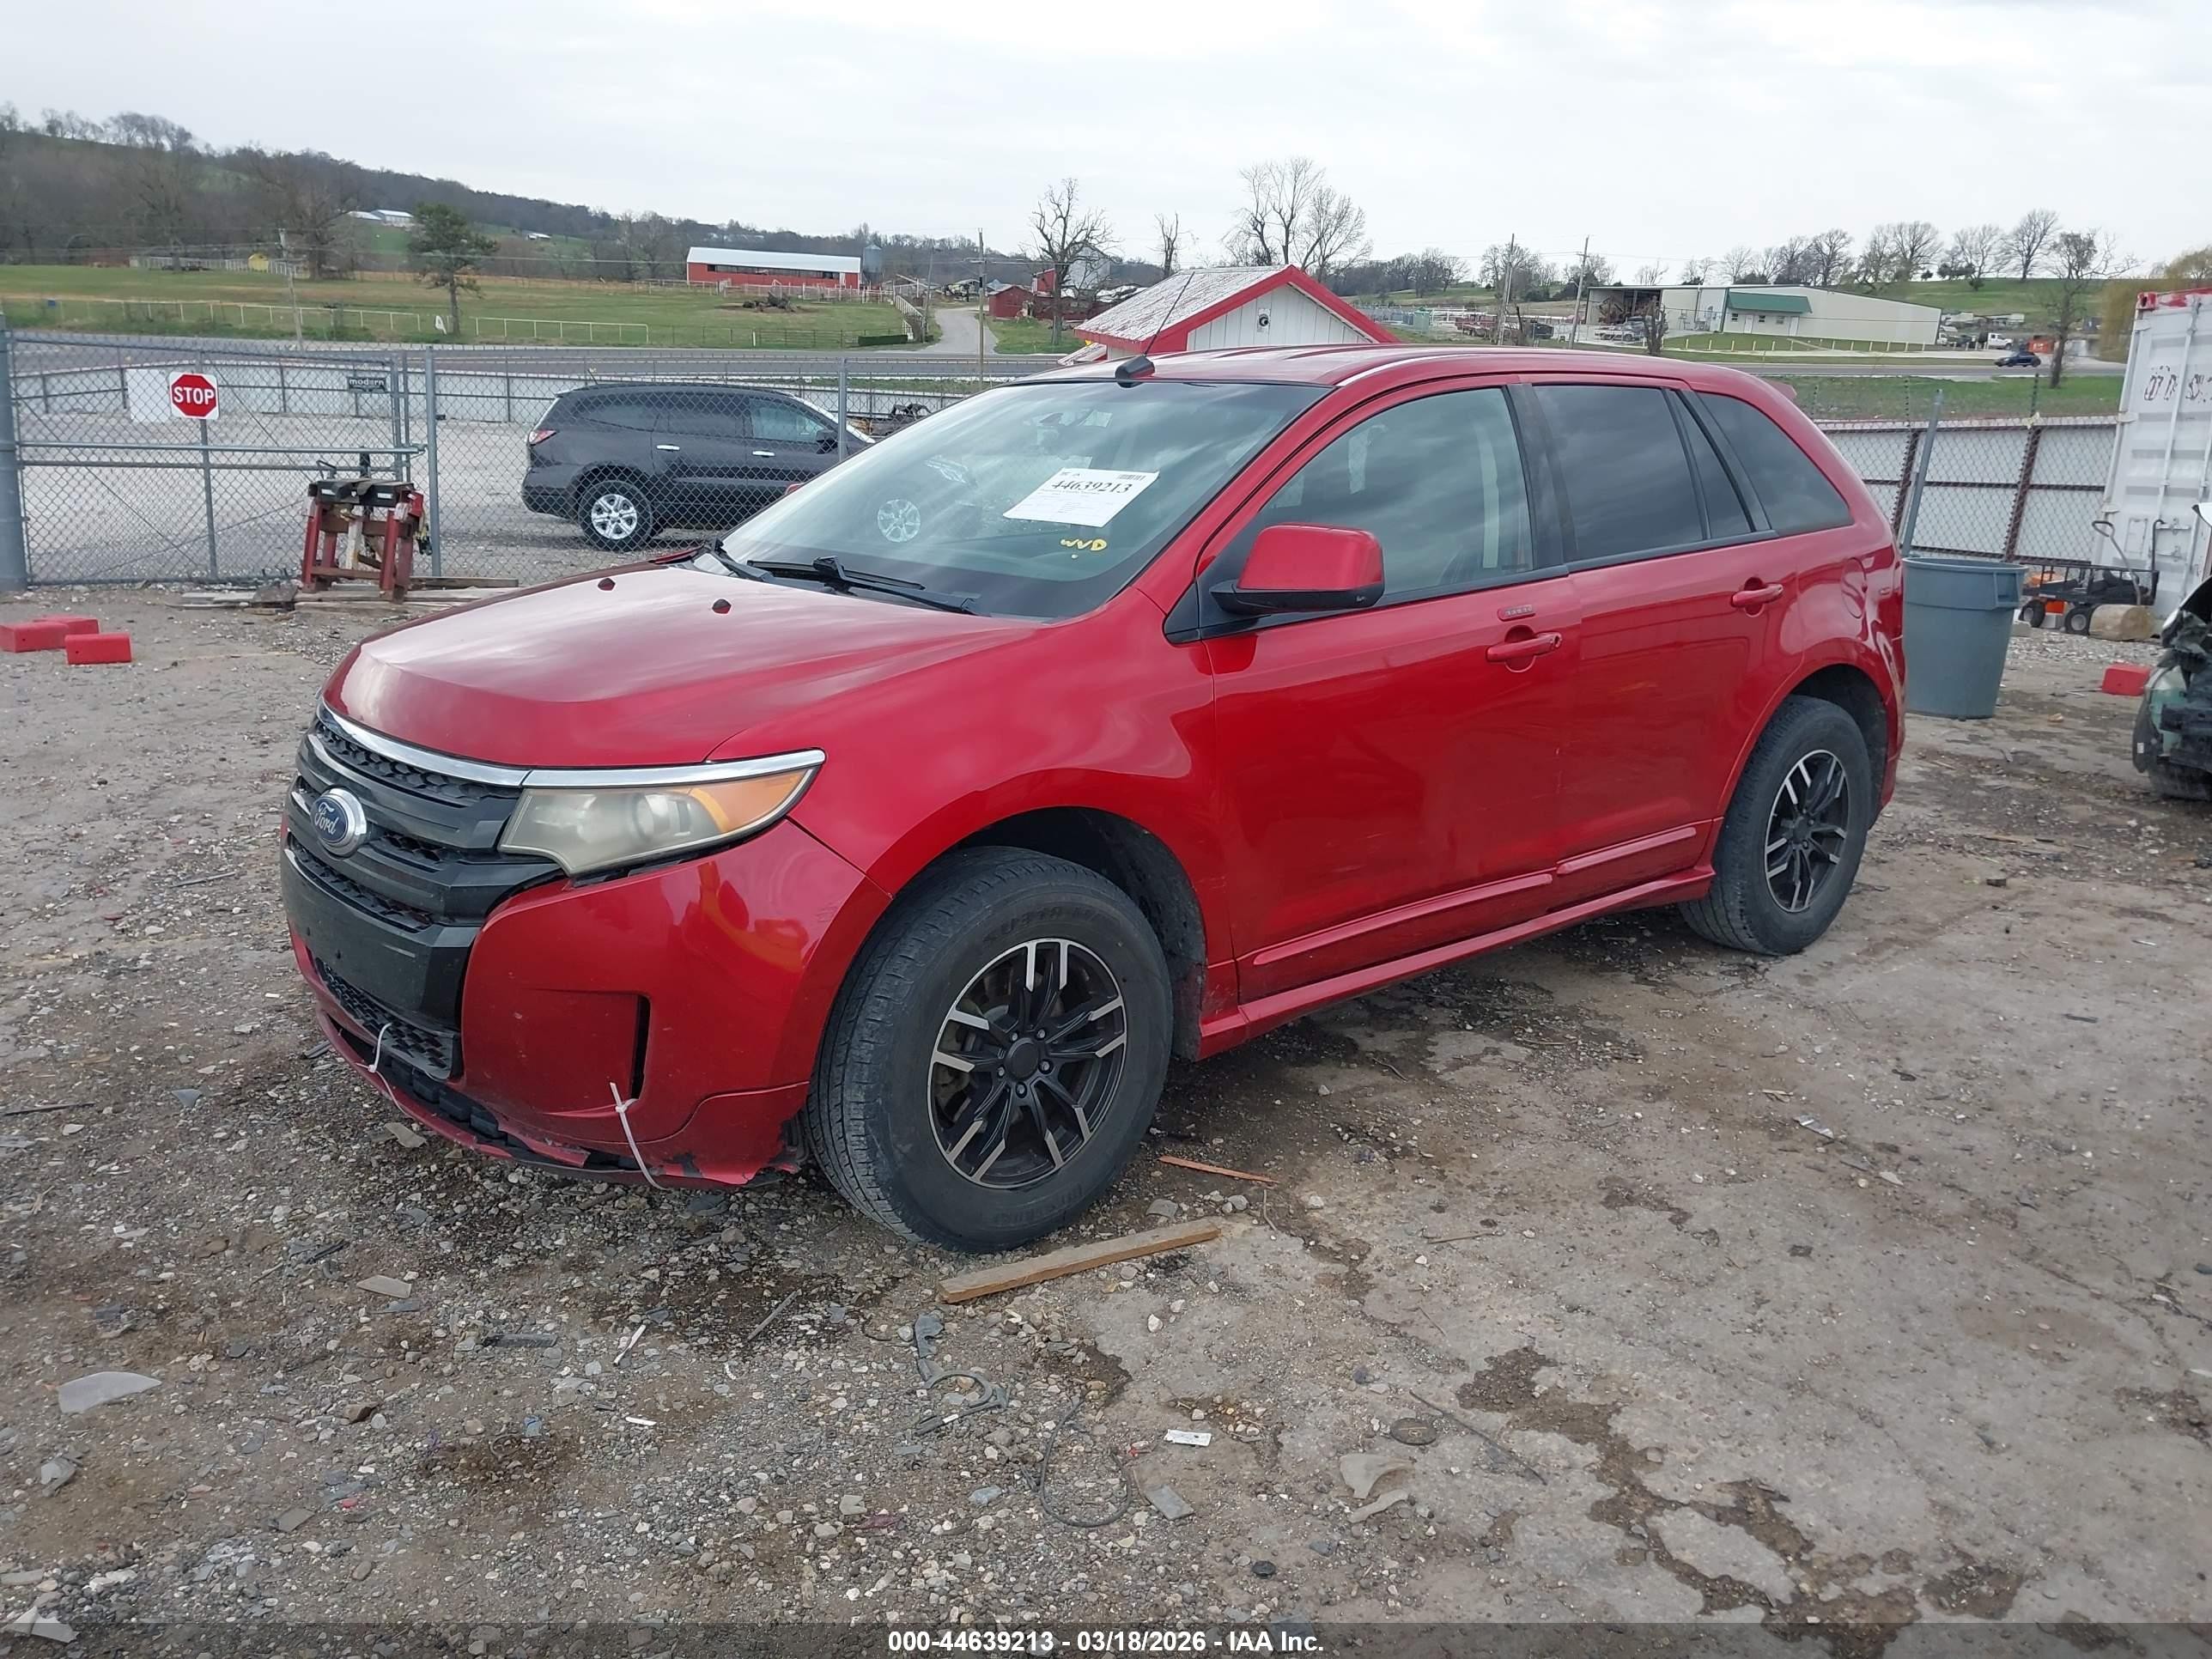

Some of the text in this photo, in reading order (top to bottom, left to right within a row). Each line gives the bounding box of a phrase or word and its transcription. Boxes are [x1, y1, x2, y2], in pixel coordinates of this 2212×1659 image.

[173, 386, 215, 404] STOP
[1051, 480, 1133, 494] 44639213
[314, 802, 339, 835] Ford
